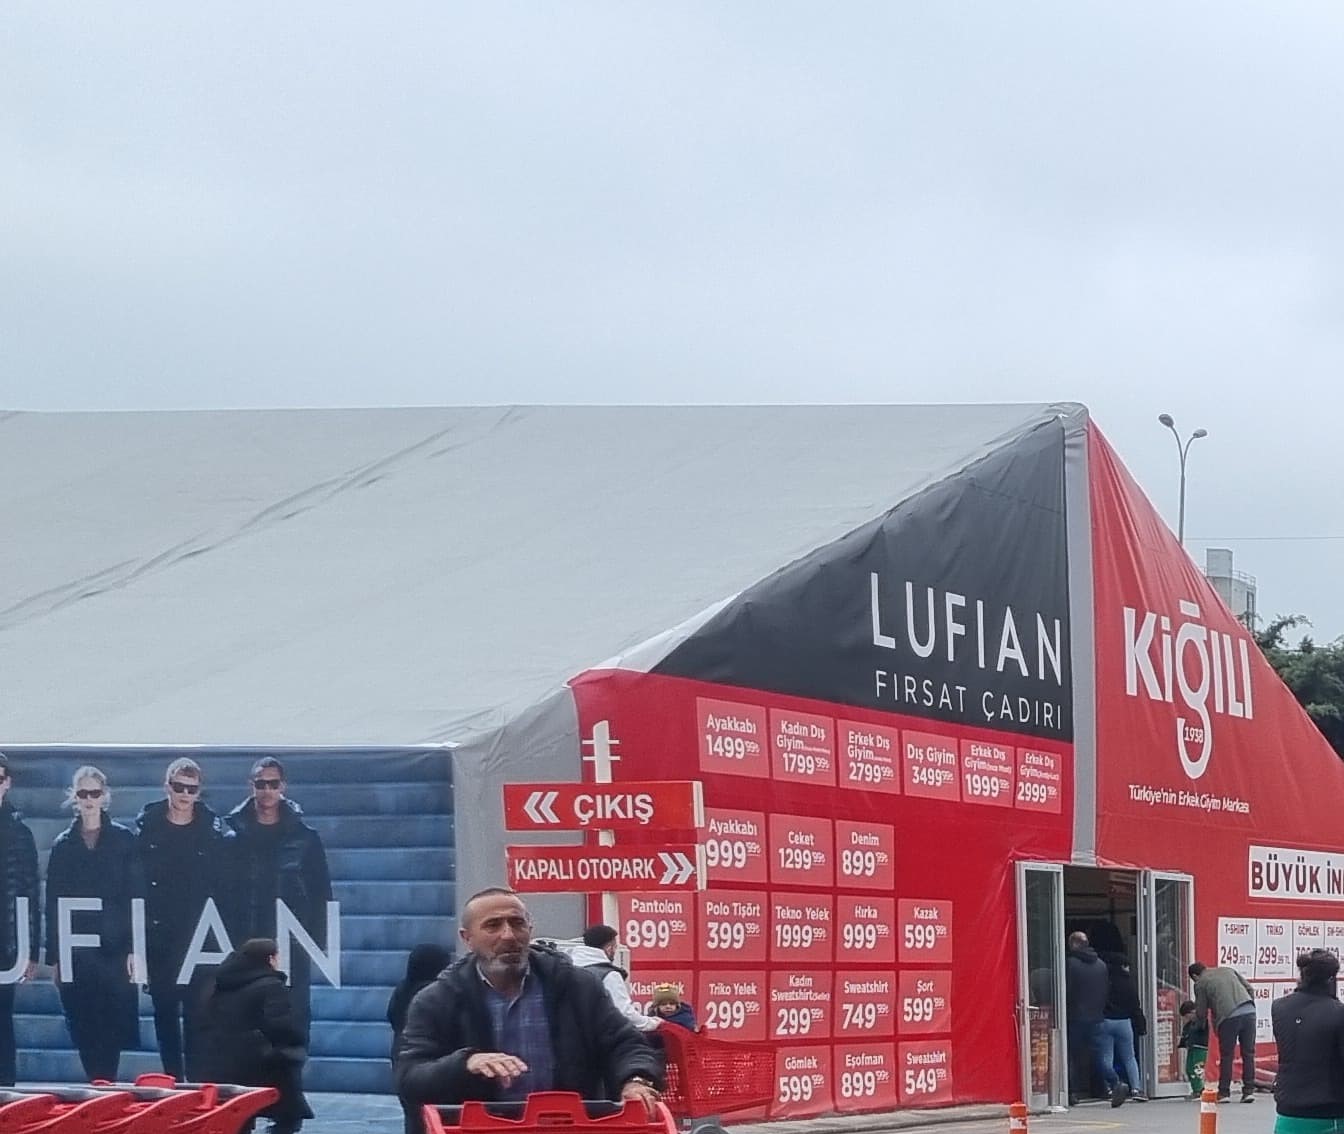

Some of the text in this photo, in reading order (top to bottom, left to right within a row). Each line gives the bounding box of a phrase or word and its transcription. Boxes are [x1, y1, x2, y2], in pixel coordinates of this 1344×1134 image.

[871, 572, 1062, 686] LUFIAN
[875, 670, 1061, 730] FIRSAT ÇADIRI
[707, 714, 756, 735] Ayakkabı
[781, 720, 826, 741] Kadın Dış
[849, 731, 890, 750] Erkek Dış
[1184, 727, 1204, 744] 1938
[907, 744, 924, 762] Dış
[927, 748, 955, 767] Giyim
[971, 745, 992, 758] Erkek
[1179, 791, 1199, 808] Erkek
[574, 794, 654, 825] ÇIKIŞ
[709, 818, 757, 836] Ayakkabı
[789, 831, 815, 846] Ceket
[851, 832, 879, 846] Denim
[515, 858, 657, 880] KAPALI OTOPARK
[1251, 853, 1321, 894] BÜYÜK
[631, 898, 682, 914] Pantolon
[707, 902, 730, 916] Polo
[776, 906, 829, 921] Tekno Yelek
[914, 907, 938, 920] Kazak
[709, 982, 757, 996] Triko Yelek
[844, 981, 888, 994] Sweatshirt
[785, 1056, 818, 1070] Gömlek
[845, 1053, 884, 1067] Eşofman
